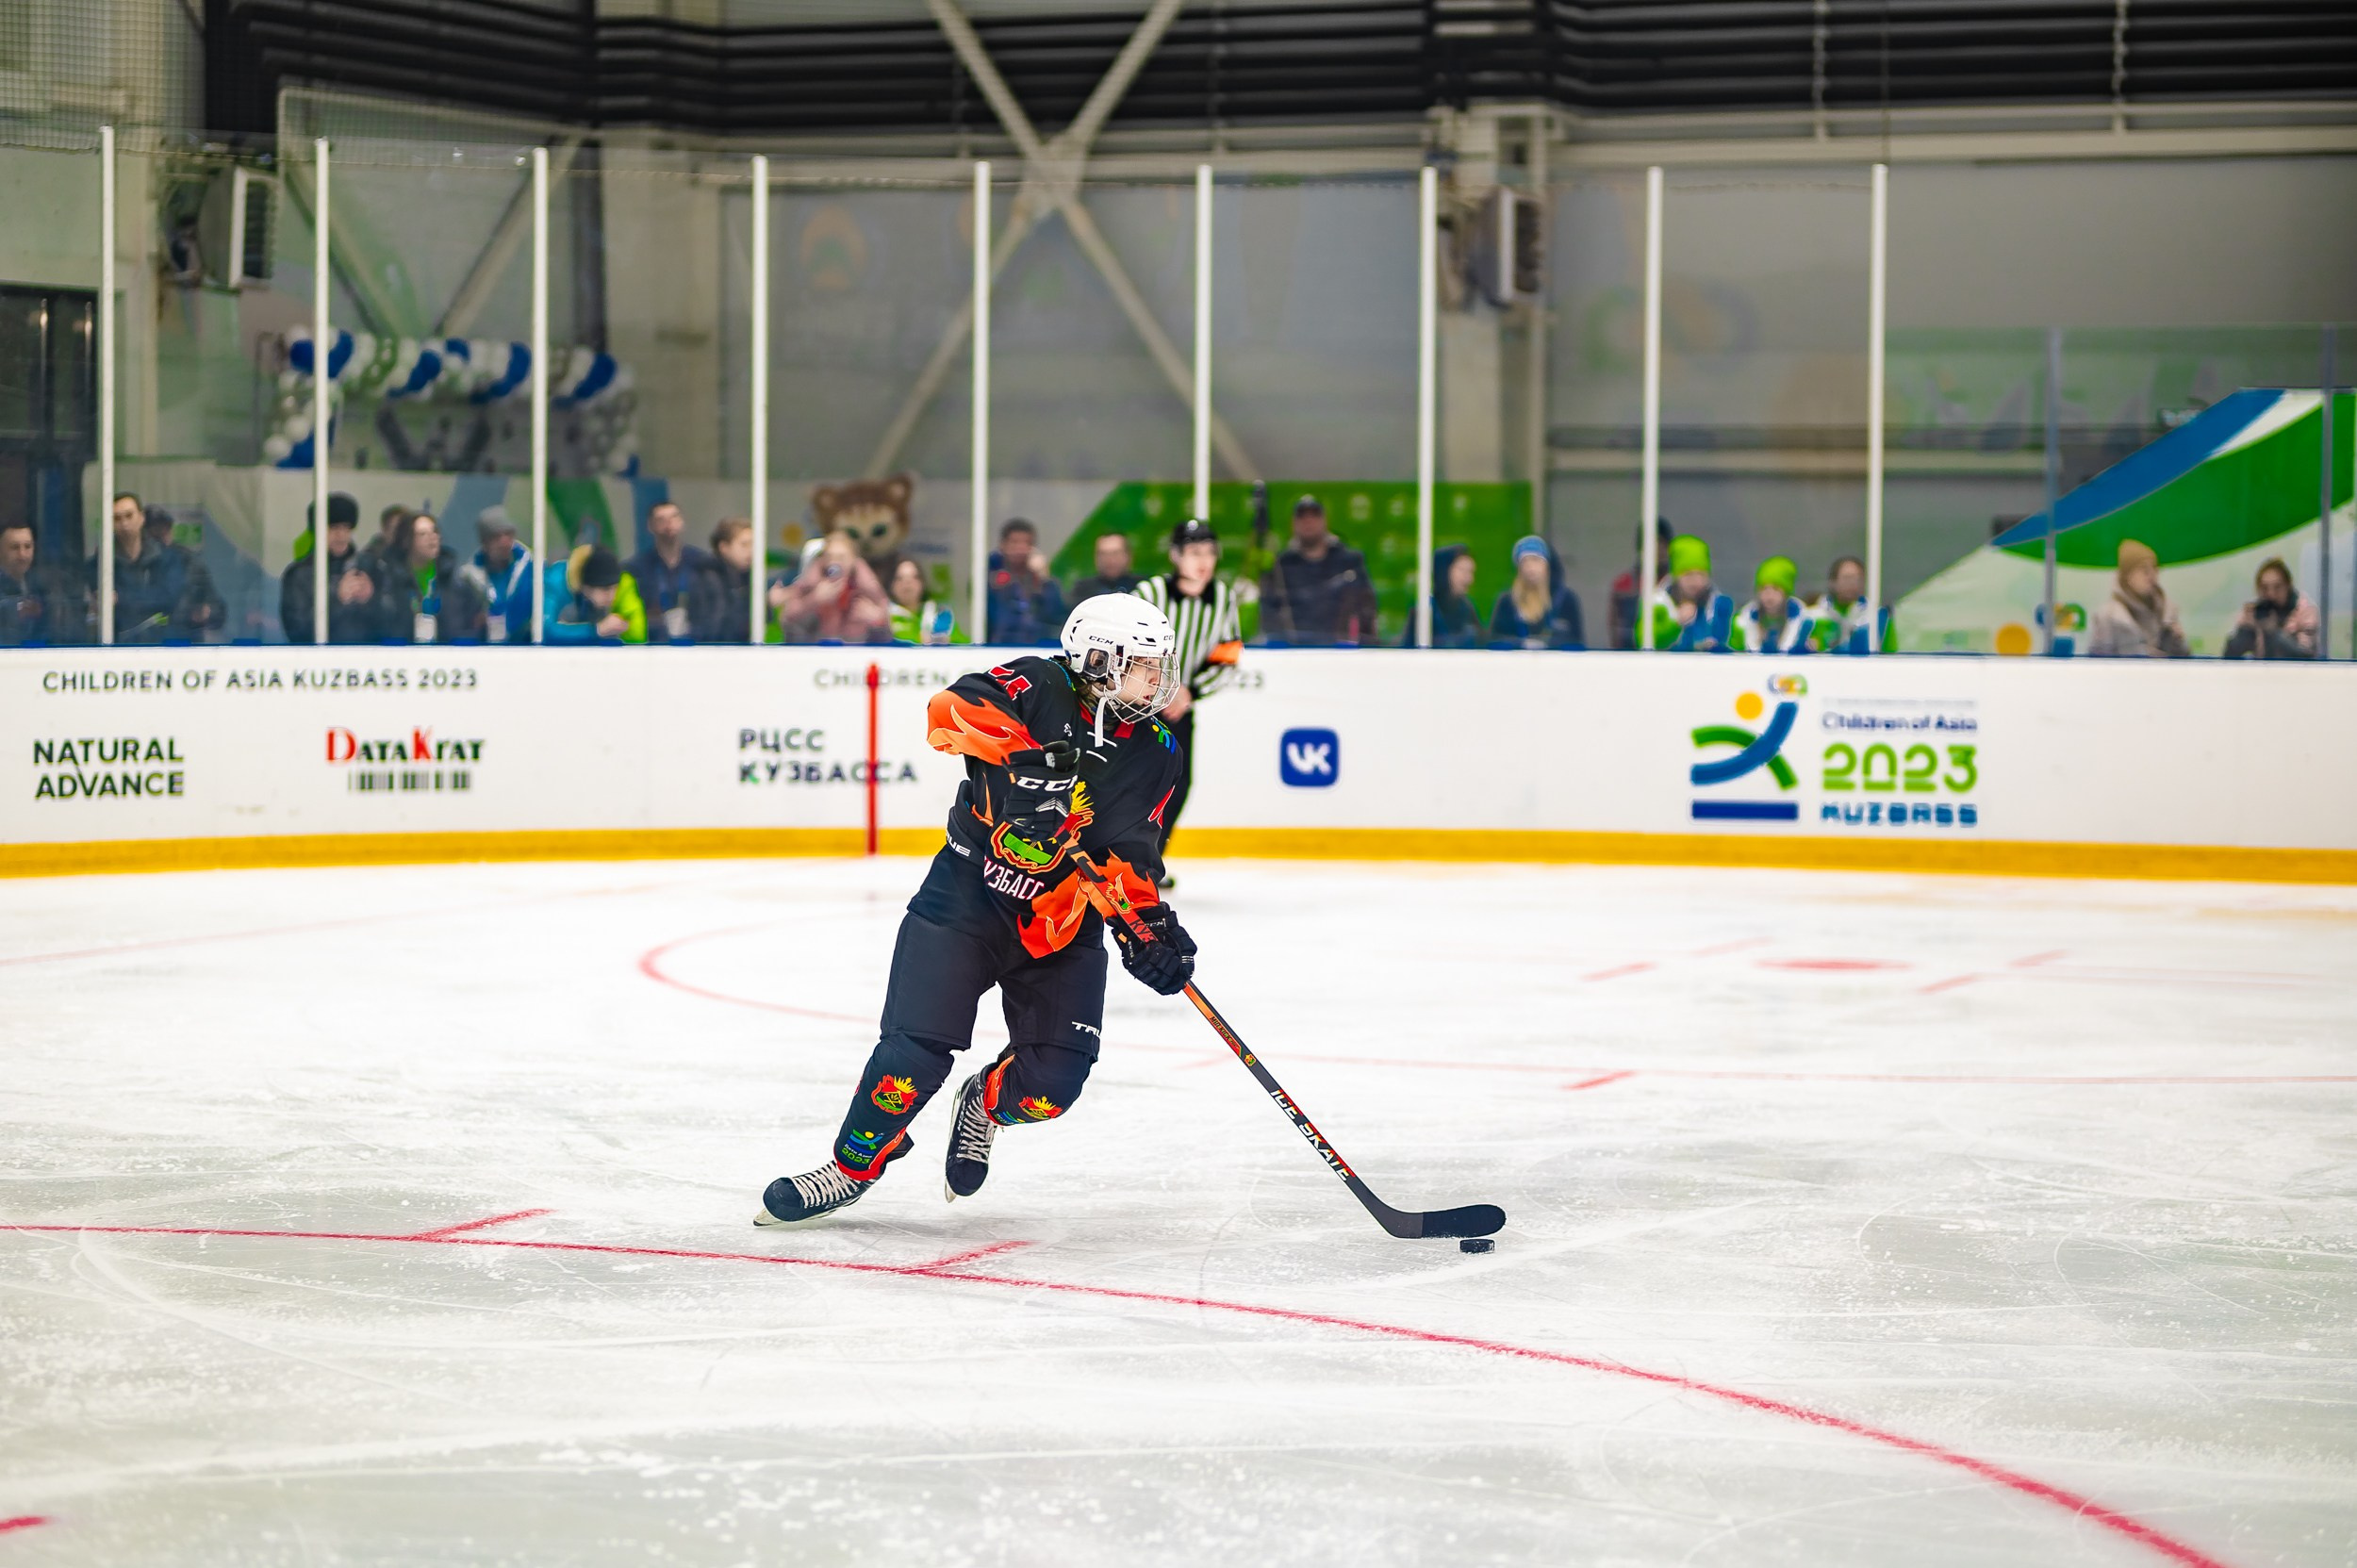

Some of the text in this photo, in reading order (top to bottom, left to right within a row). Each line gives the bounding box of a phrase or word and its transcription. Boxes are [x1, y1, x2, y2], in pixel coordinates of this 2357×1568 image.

[1089, 635, 1114, 645] CCM
[42, 668, 478, 693] CHILDREN OF ASIA KUZBASS 2023
[33, 737, 184, 765] NATURAL
[738, 729, 825, 752] РЦСС
[738, 762, 917, 784] КУЗБАССА
[1822, 742, 1978, 793] 2023
[35, 771, 184, 799] ADVANCE
[1821, 802, 1978, 828] KUZBASS
[983, 855, 1045, 900] УЗБАСС
[1270, 1089, 1356, 1181] ICE SKATE
[841, 1147, 871, 1164] 2023
